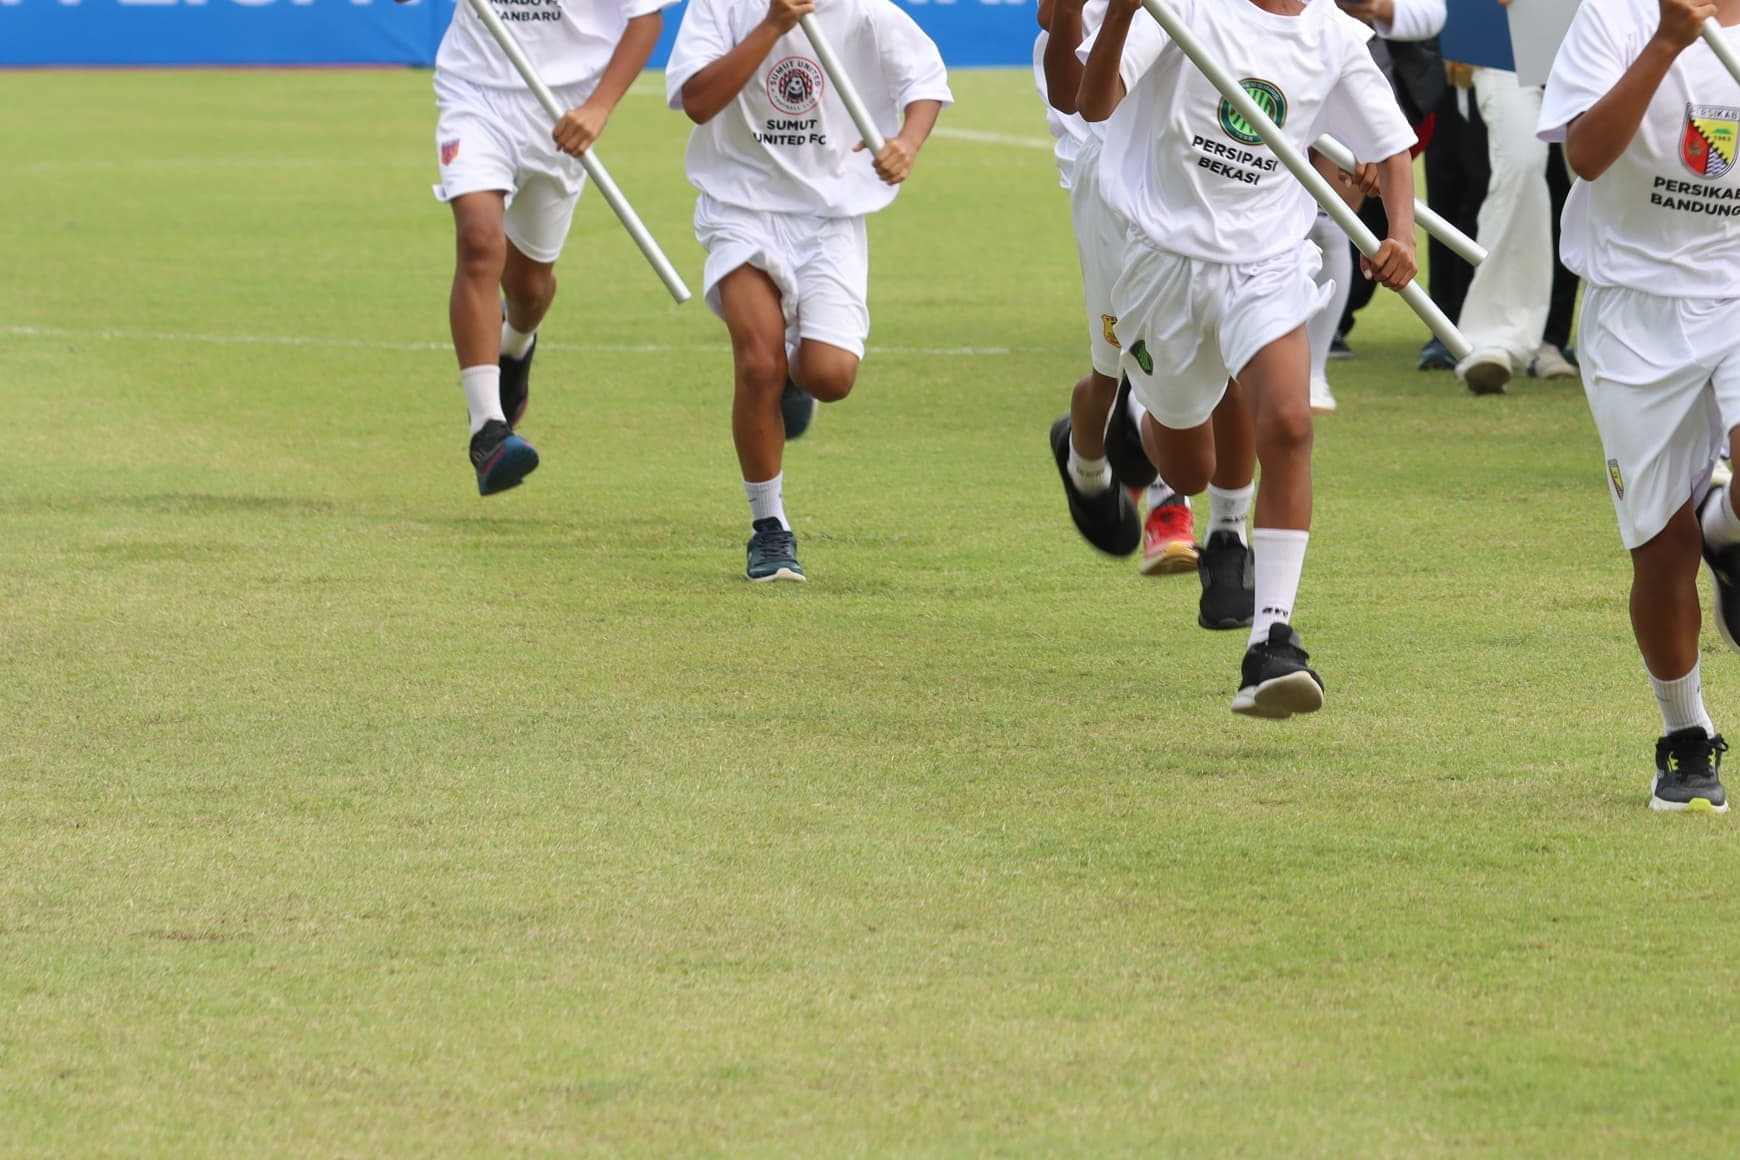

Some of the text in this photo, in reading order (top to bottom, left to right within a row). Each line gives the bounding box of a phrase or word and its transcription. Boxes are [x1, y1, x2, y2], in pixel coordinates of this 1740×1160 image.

[770, 60, 795, 86] SUMUT
[766, 119, 819, 131] SUMUT
[753, 131, 827, 146] UNITED FC
[1191, 135, 1279, 172] PERSIPASI
[1197, 156, 1262, 186] BEKASI
